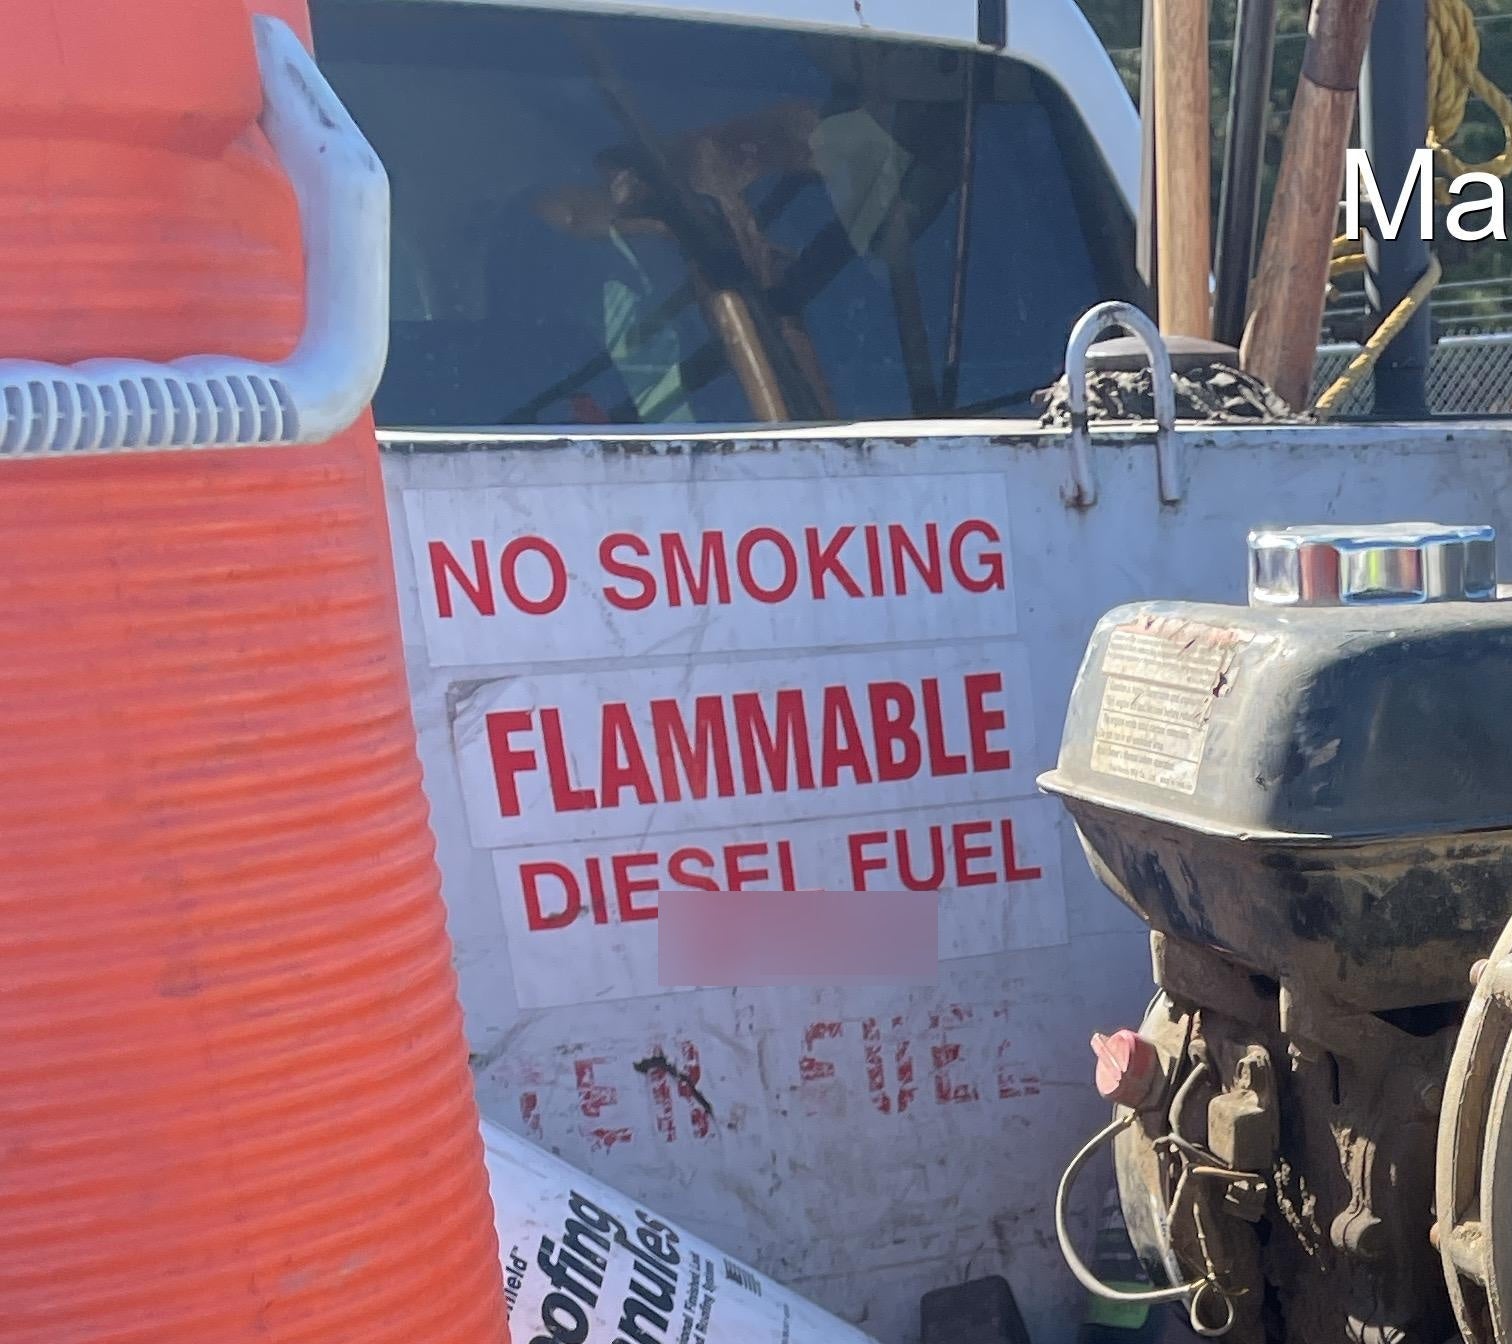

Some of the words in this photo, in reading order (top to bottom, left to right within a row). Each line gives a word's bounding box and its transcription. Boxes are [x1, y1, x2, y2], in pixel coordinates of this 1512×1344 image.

[427, 536, 568, 618] NO
[600, 519, 1007, 610] SMOKING
[486, 672, 1012, 817] FLAMMABLE
[848, 819, 1042, 893] FUEL
